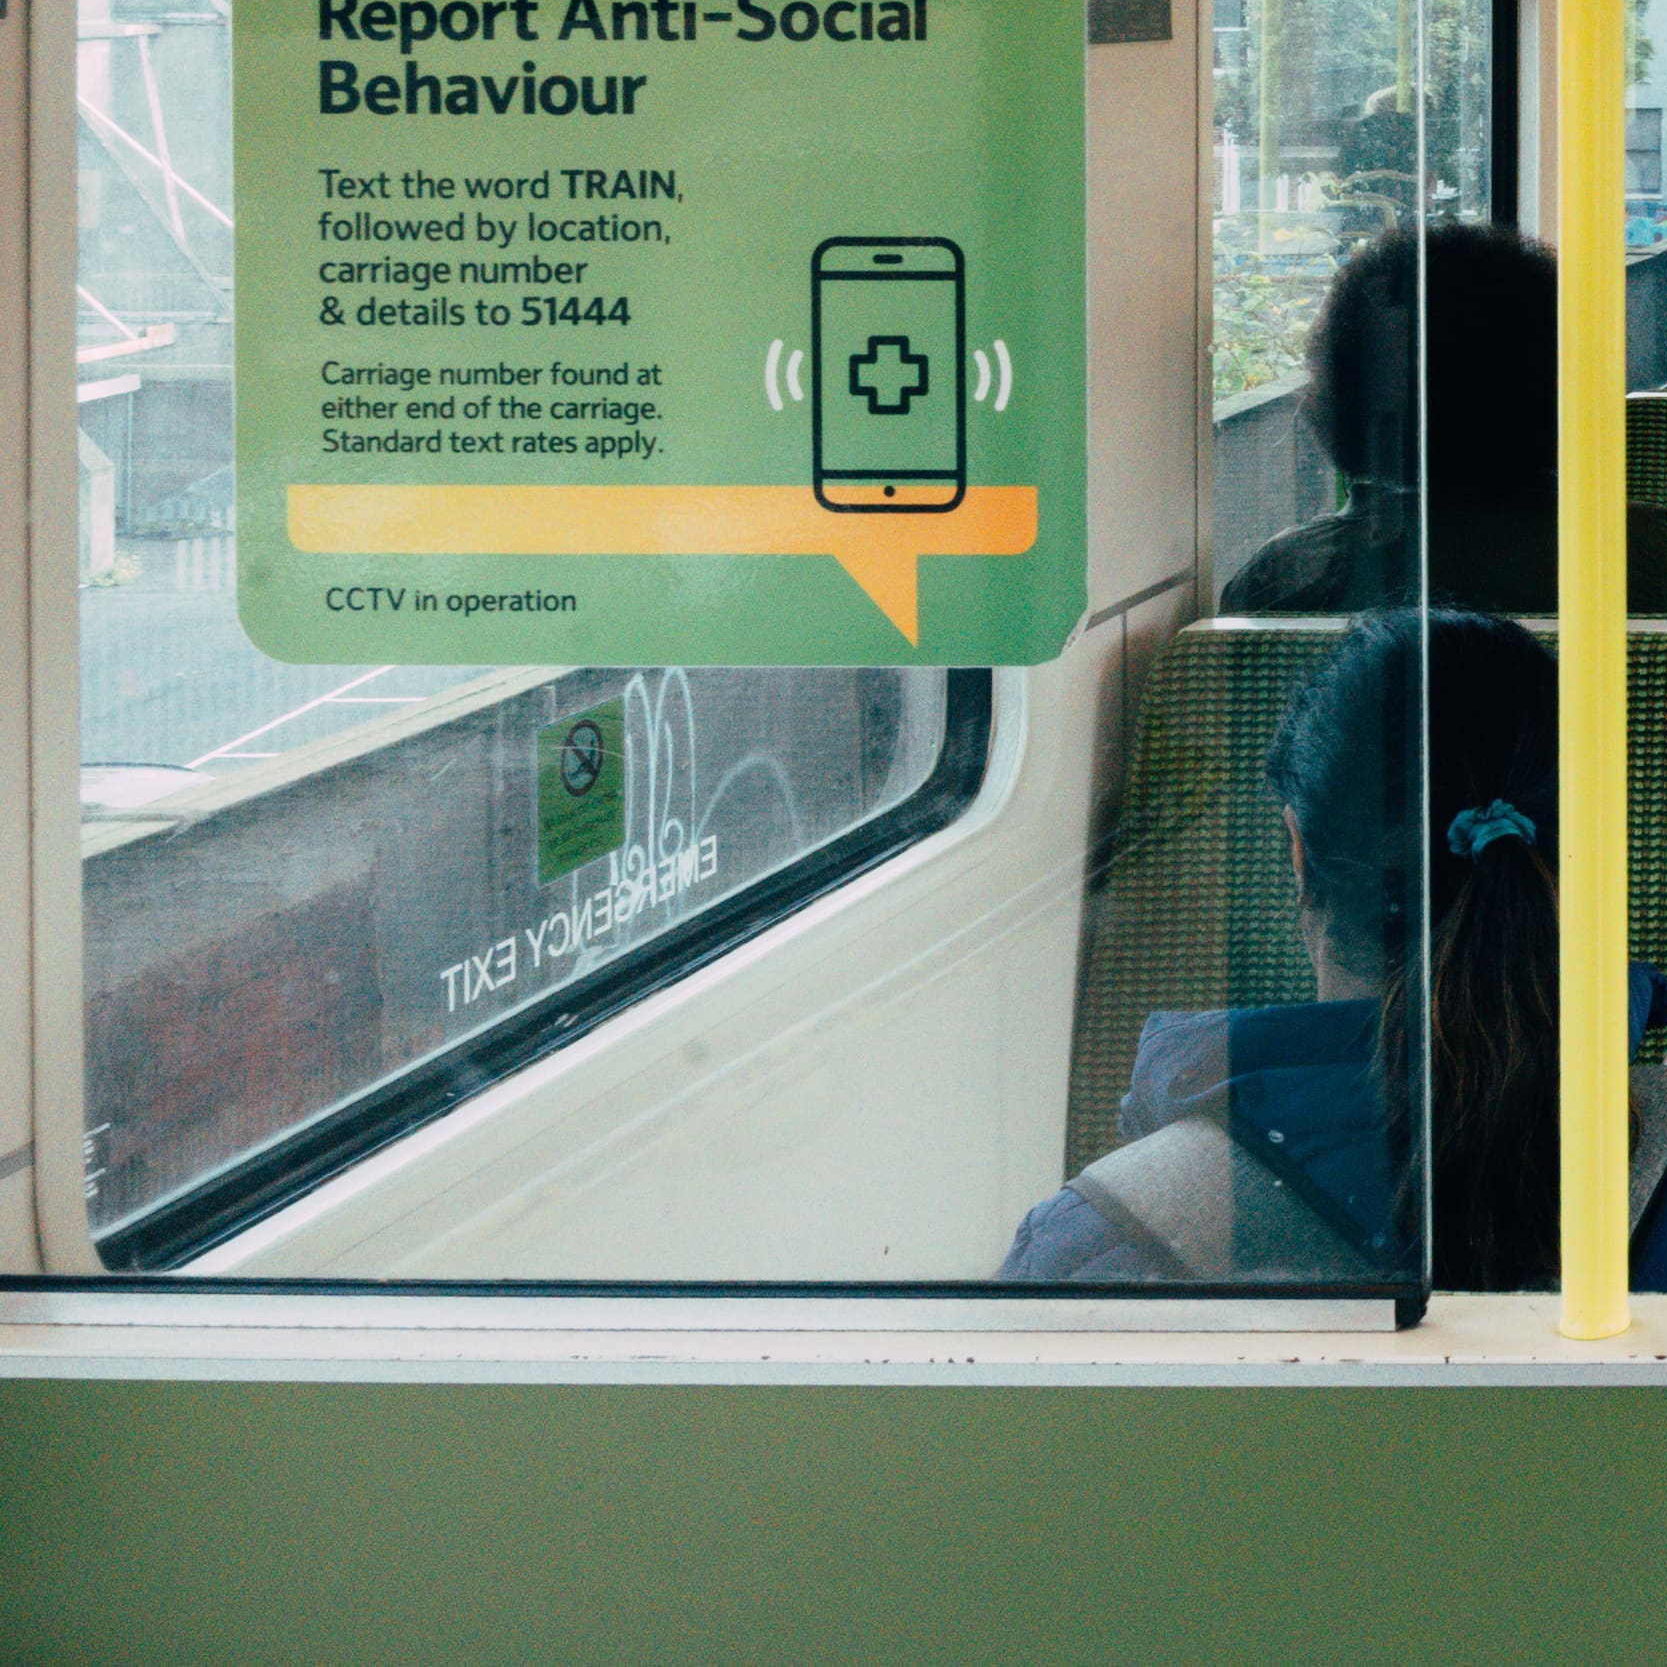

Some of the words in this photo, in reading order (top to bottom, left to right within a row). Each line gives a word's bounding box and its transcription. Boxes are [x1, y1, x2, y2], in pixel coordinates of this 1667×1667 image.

[317, 61, 647, 115] Behaviour
[320, 170, 391, 200] Text
[402, 170, 455, 200] the
[465, 169, 550, 200] word
[561, 171, 684, 204] TRAIN,
[318, 212, 464, 242] followed
[476, 212, 516, 248] by
[528, 212, 671, 248] location,
[320, 257, 450, 291] carriage
[460, 255, 587, 285] number
[320, 299, 346, 326] &
[355, 295, 466, 326] details
[475, 298, 510, 326] to
[521, 297, 631, 326] 51444
[321, 362, 429, 392] Carriage
[439, 361, 542, 387] number
[550, 360, 627, 387] found
[636, 364, 662, 387] at
[321, 395, 398, 421] either
[407, 395, 453, 421] end
[463, 394, 490, 421] of
[500, 395, 542, 421] the
[550, 396, 663, 427] carriage.
[322, 429, 442, 455] Standard
[450, 430, 505, 455] text
[512, 430, 576, 455] rates
[585, 429, 665, 460] apply.
[325, 587, 406, 613] CCTV
[414, 587, 438, 613] in
[445, 588, 578, 618] operation
